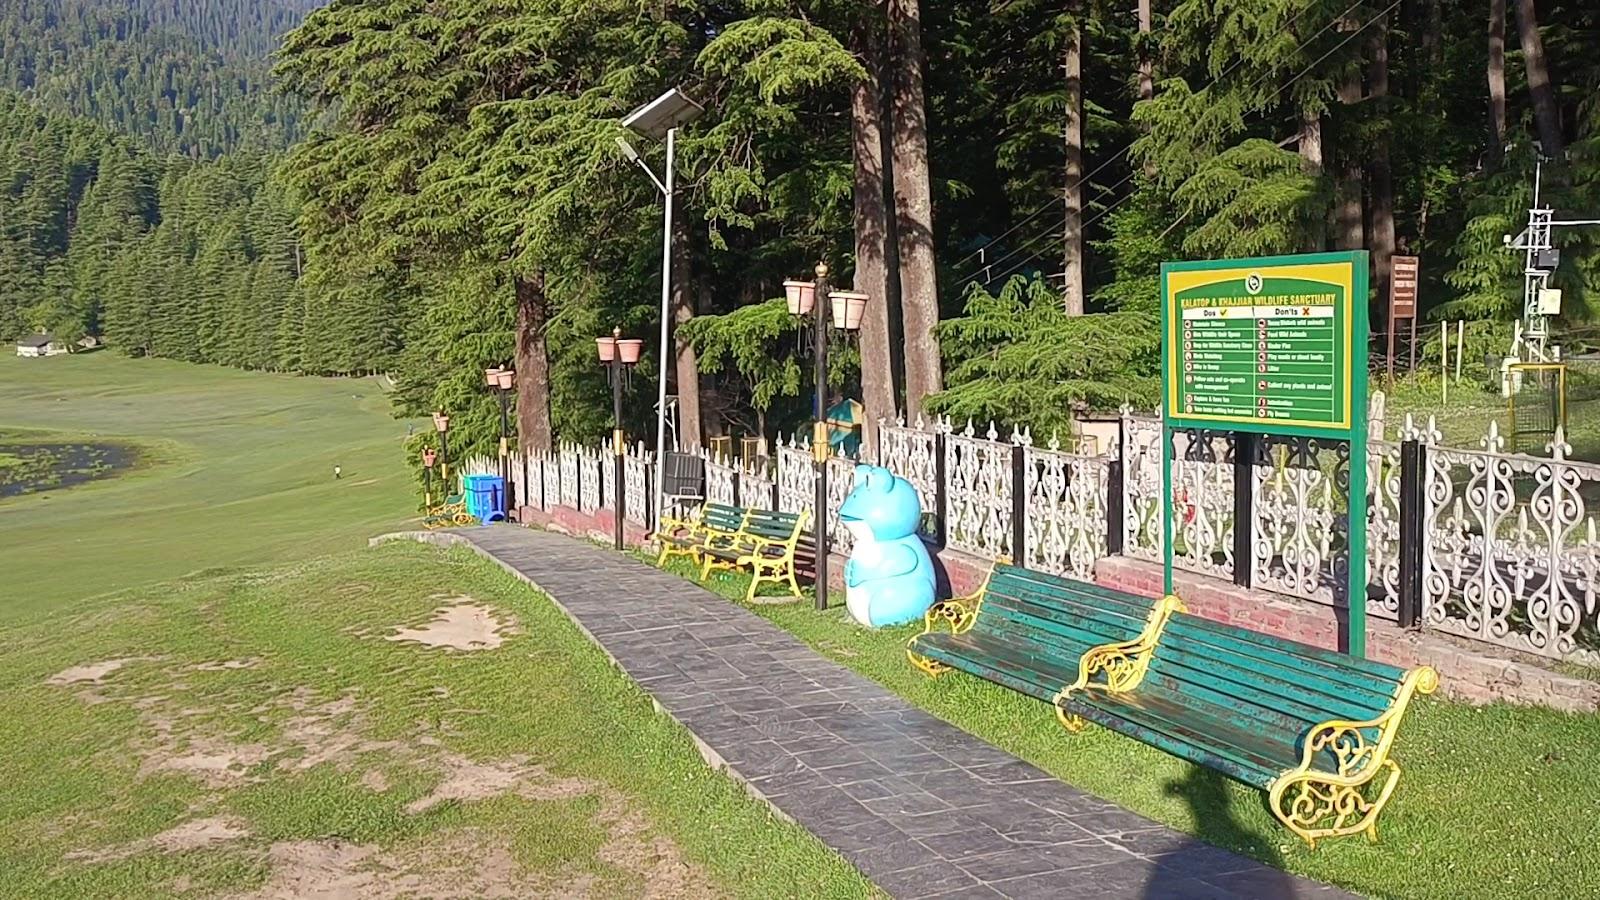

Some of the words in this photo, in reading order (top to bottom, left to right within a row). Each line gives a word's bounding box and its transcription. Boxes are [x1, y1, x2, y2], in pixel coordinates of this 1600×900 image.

[1181, 298, 1210, 308] KALATOP
[1254, 296, 1288, 305] WILDLIFE
[1290, 294, 1335, 305] SANCTUARY
